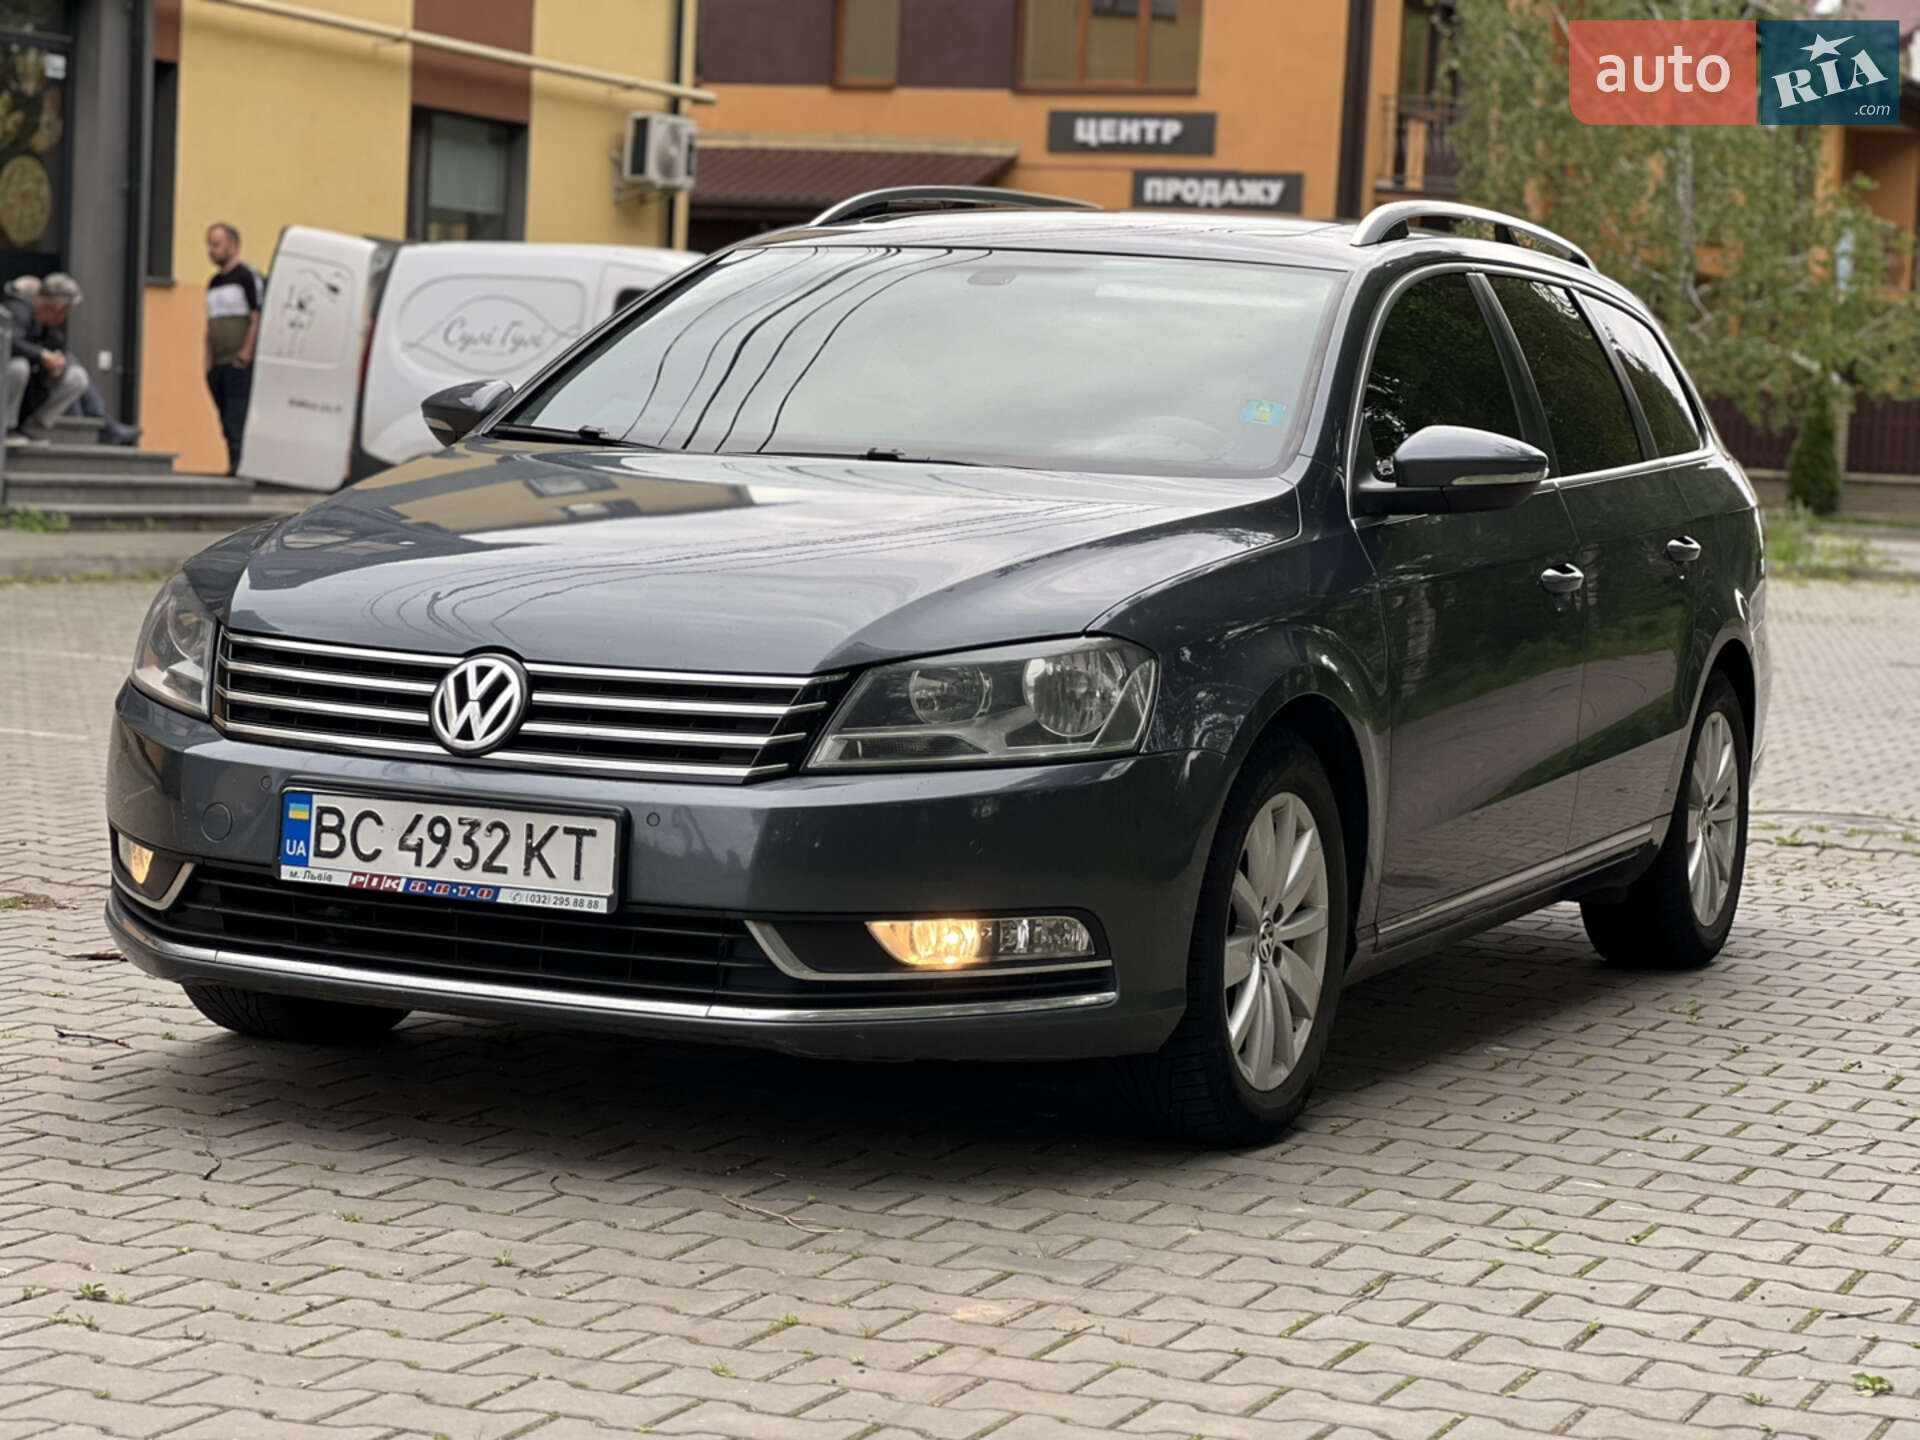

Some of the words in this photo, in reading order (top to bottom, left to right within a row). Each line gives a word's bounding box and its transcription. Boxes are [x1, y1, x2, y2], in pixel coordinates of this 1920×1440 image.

[1073, 117, 1184, 146] ЦЕНТР
[1142, 176, 1285, 207] ПРОДАЖУ
[286, 838, 307, 857] UA
[313, 805, 384, 863] BC
[398, 813, 511, 875] 4932
[523, 822, 598, 882] KT
[552, 895, 570, 907] 295
[572, 897, 585, 909] 88
[587, 899, 600, 910] 88
